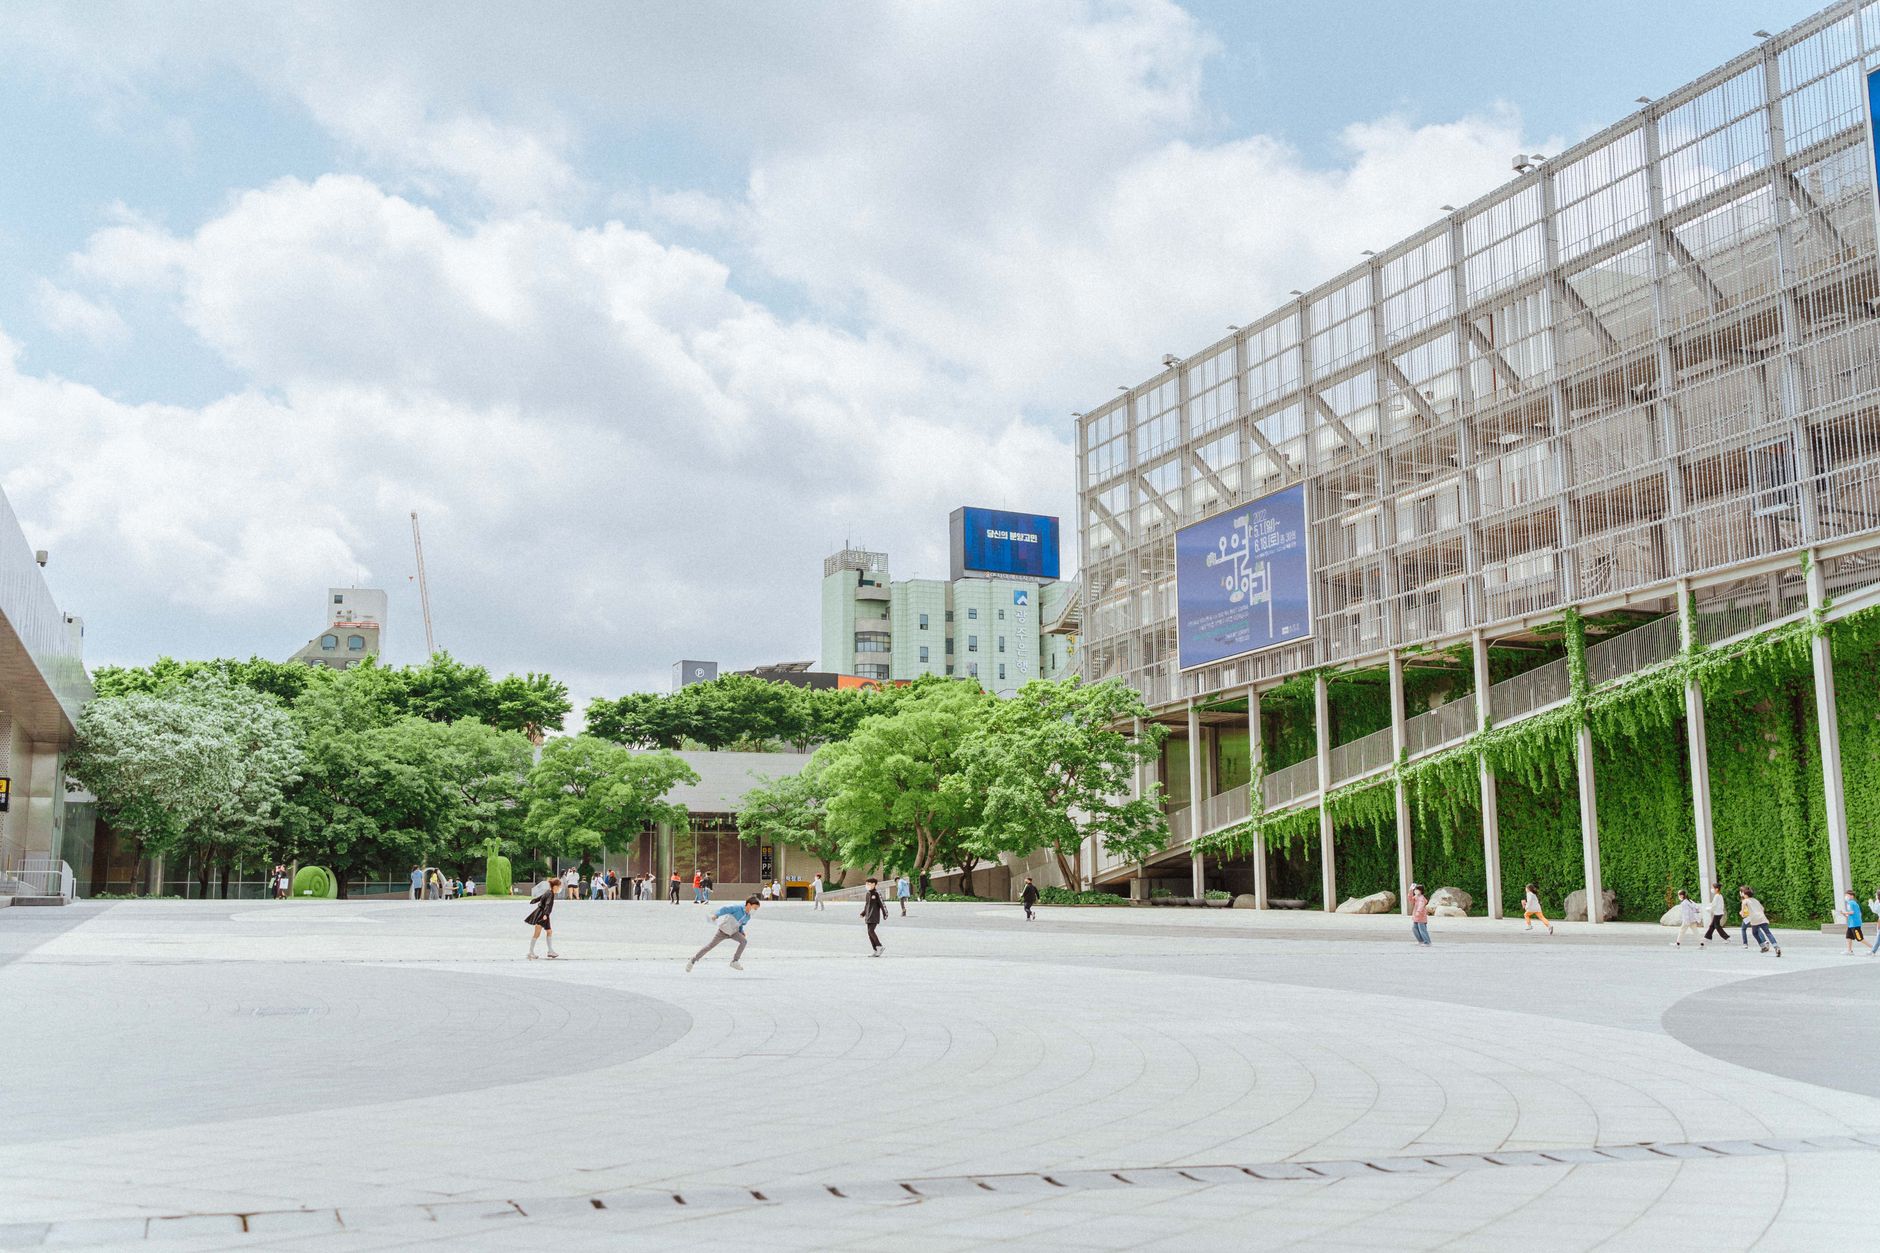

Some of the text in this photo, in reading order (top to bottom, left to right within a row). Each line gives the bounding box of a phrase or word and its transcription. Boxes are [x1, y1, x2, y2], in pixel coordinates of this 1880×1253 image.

[987, 529, 1038, 543] 당신의 분양고민
[1016, 610, 1028, 673] 광주은행
